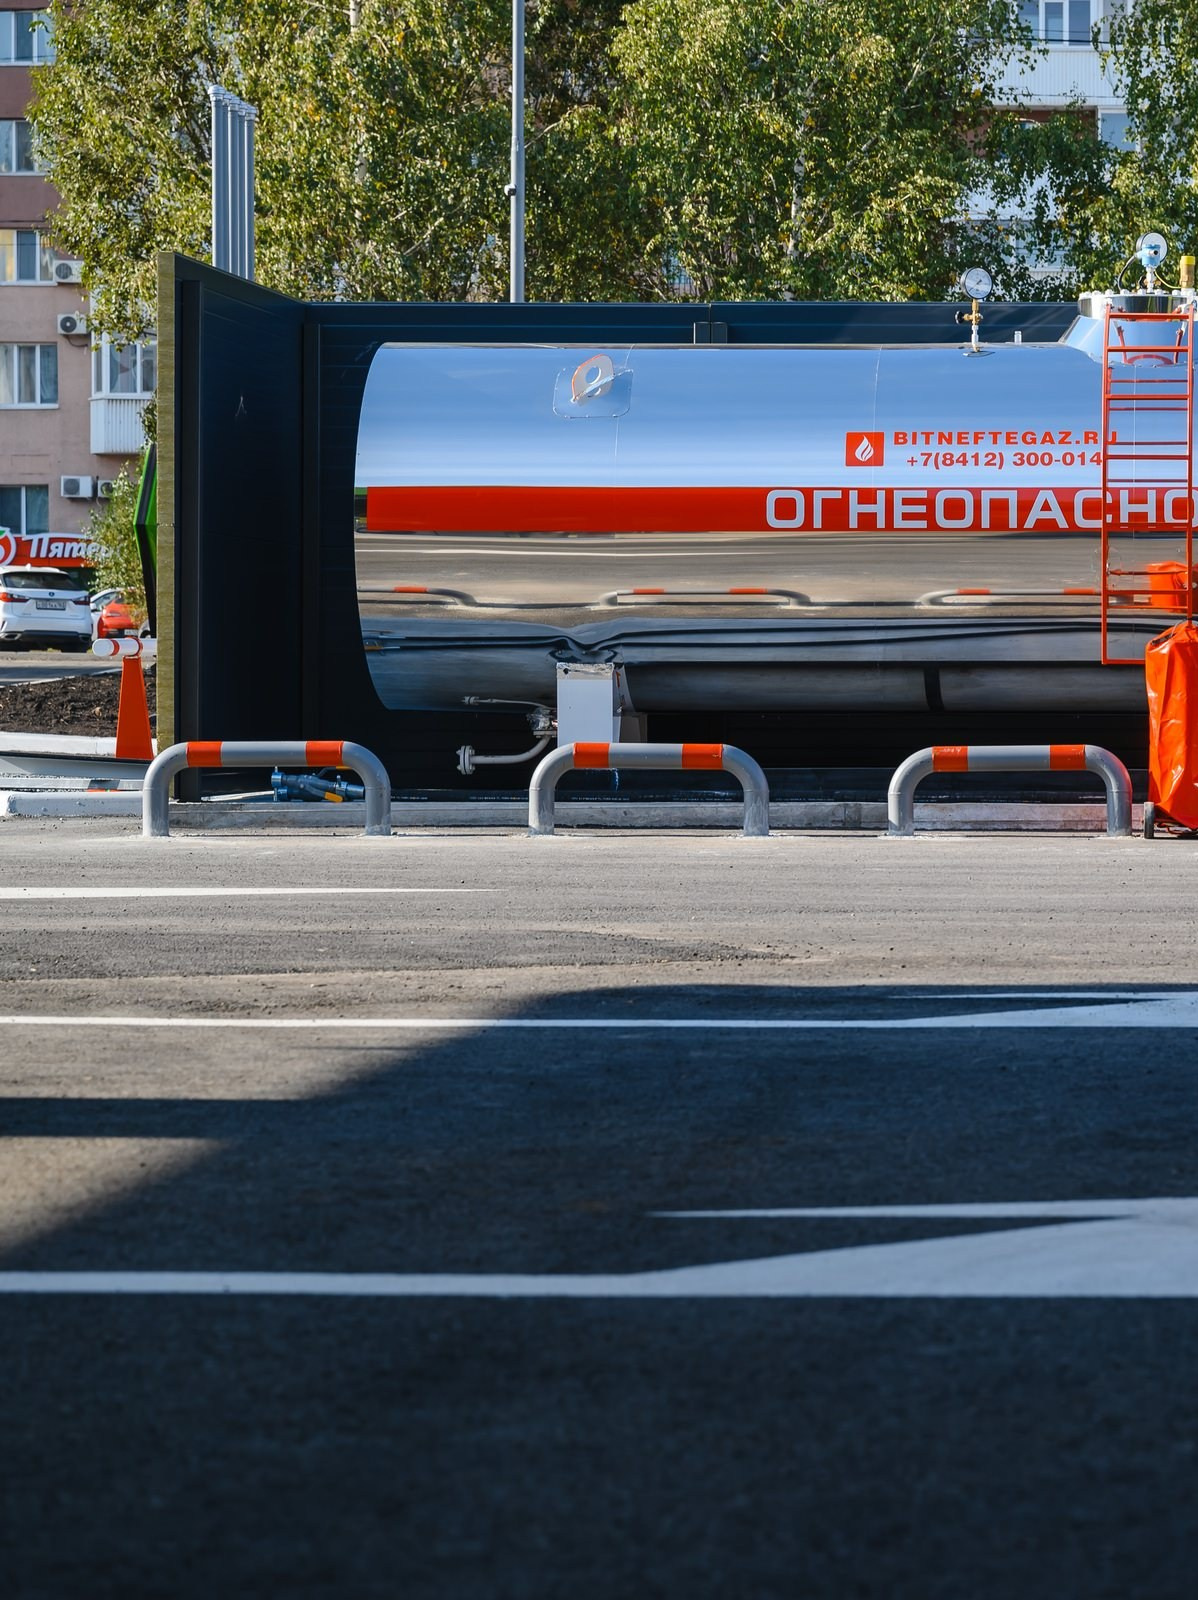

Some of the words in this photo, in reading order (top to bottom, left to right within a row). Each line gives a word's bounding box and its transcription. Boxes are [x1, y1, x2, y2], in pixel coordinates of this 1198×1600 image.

[893, 431, 1117, 445] BITNEFTEGAZ.RU
[907, 452, 1004, 470] +7(8412)
[1012, 452, 1102, 466] 300-014
